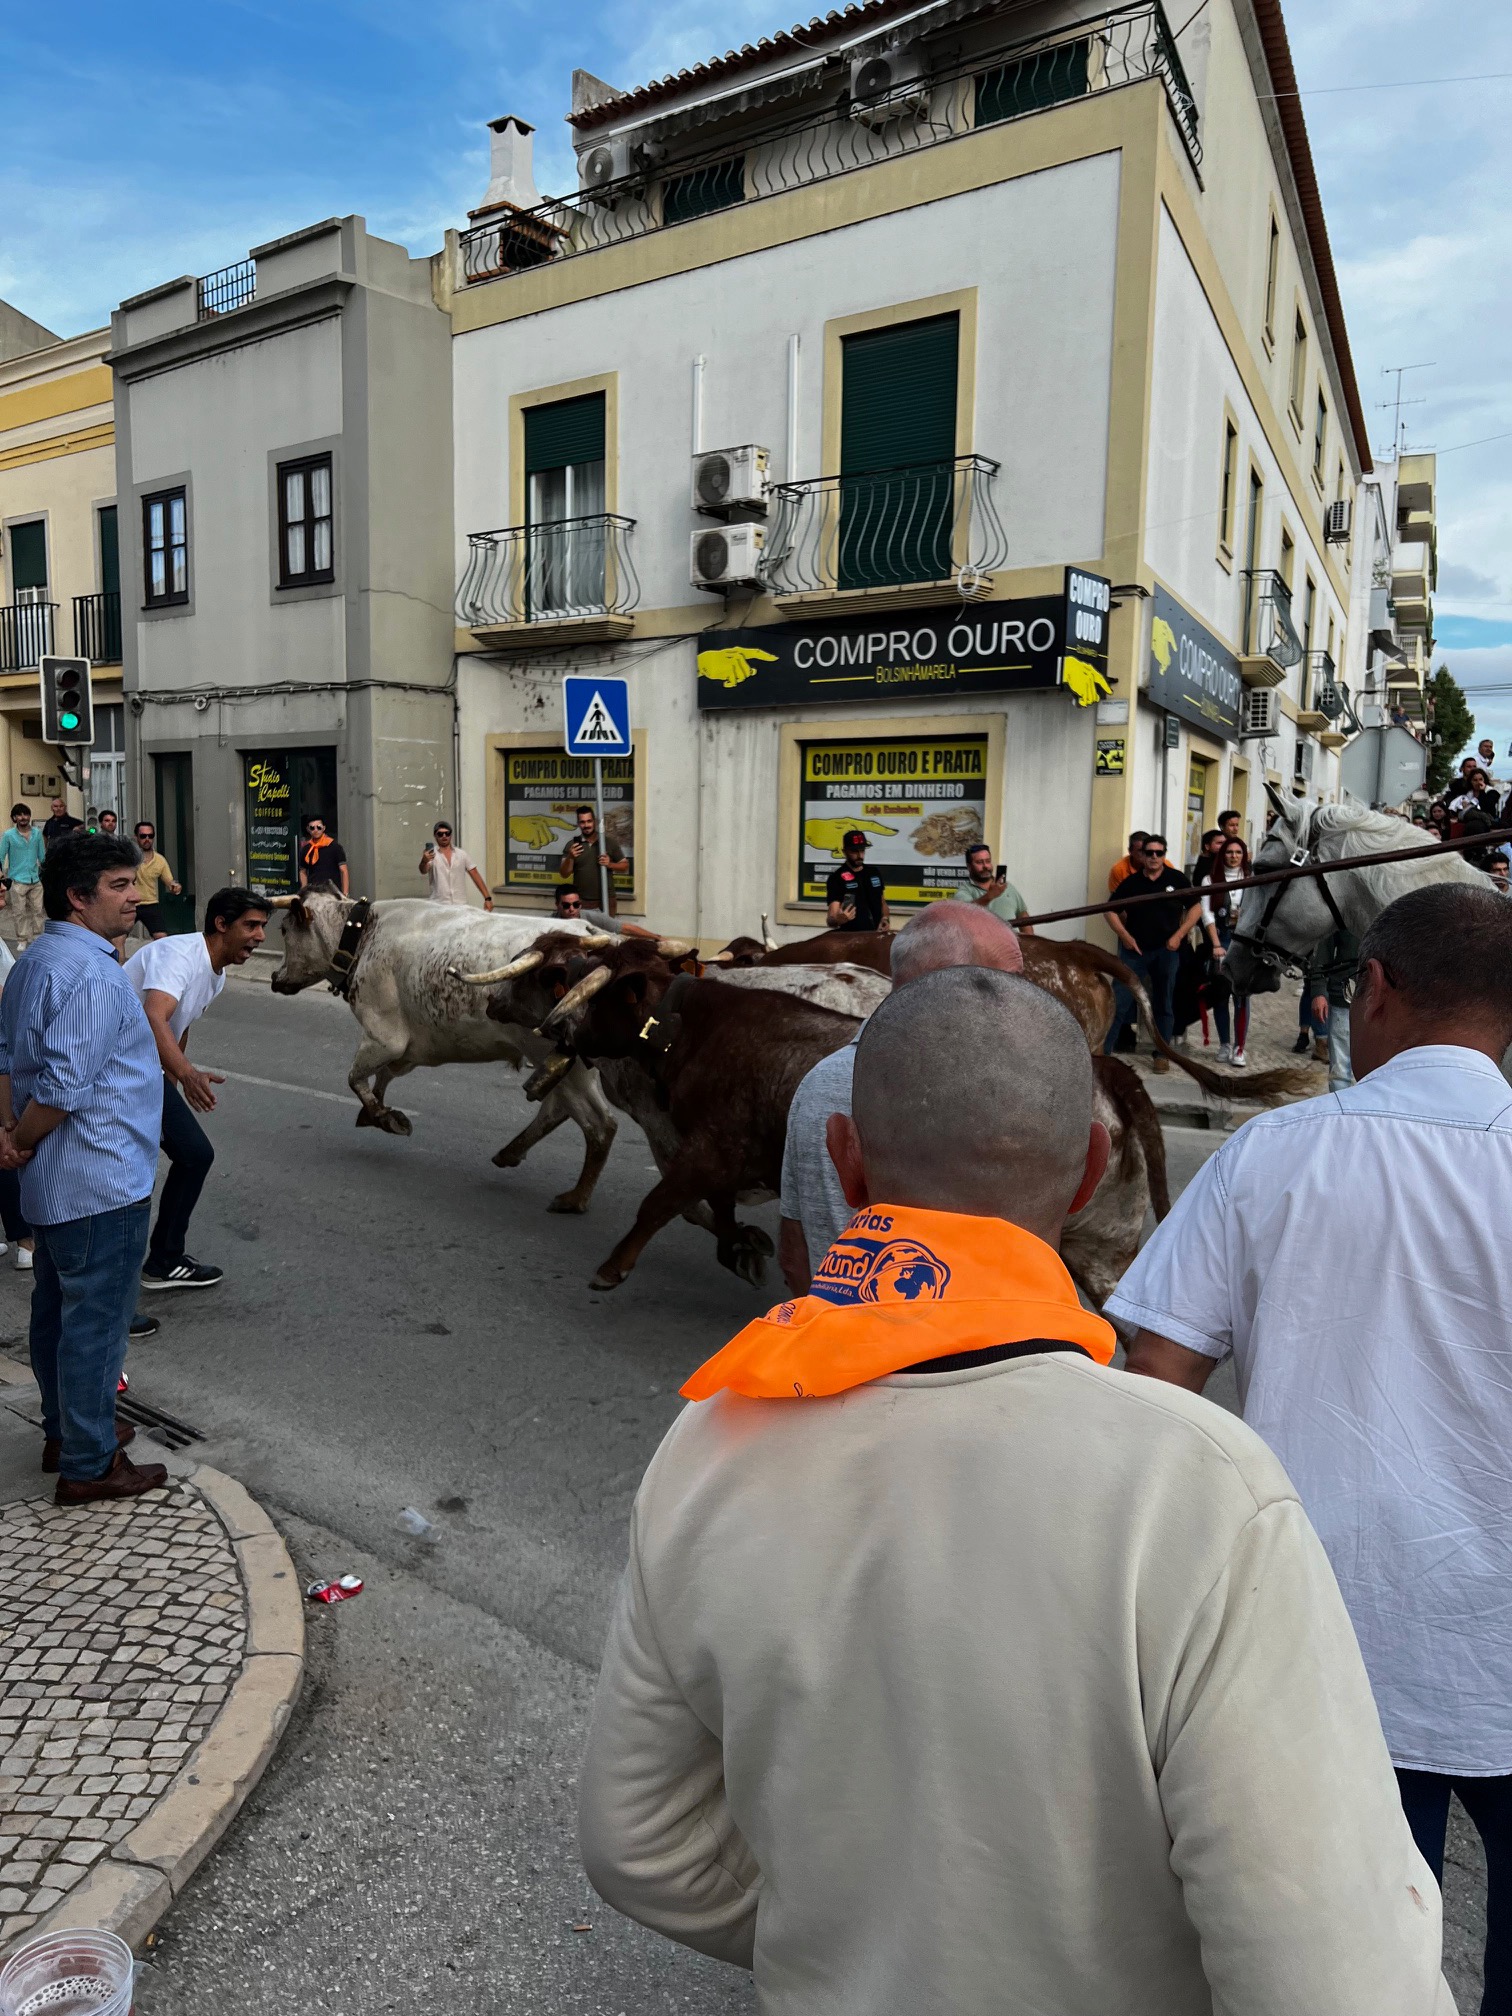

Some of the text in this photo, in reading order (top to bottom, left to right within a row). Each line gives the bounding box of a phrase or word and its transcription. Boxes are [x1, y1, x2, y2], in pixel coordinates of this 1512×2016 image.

[1069, 572, 1110, 613] COMPRO
[1075, 609, 1102, 644] OURO
[793, 617, 1056, 669] COMPRO OURO
[1180, 633, 1219, 697] COMPRO
[248, 759, 280, 788] Studio
[513, 760, 558, 779] COMPRO
[560, 759, 590, 779] OURO
[812, 749, 982, 776] COMPRO OURO E PRATA
[260, 783, 291, 802] Capelli
[524, 786, 624, 799] PAGAMOS EM DINEIRO
[826, 783, 965, 798] PAGAMOS EM DINHEIRO
